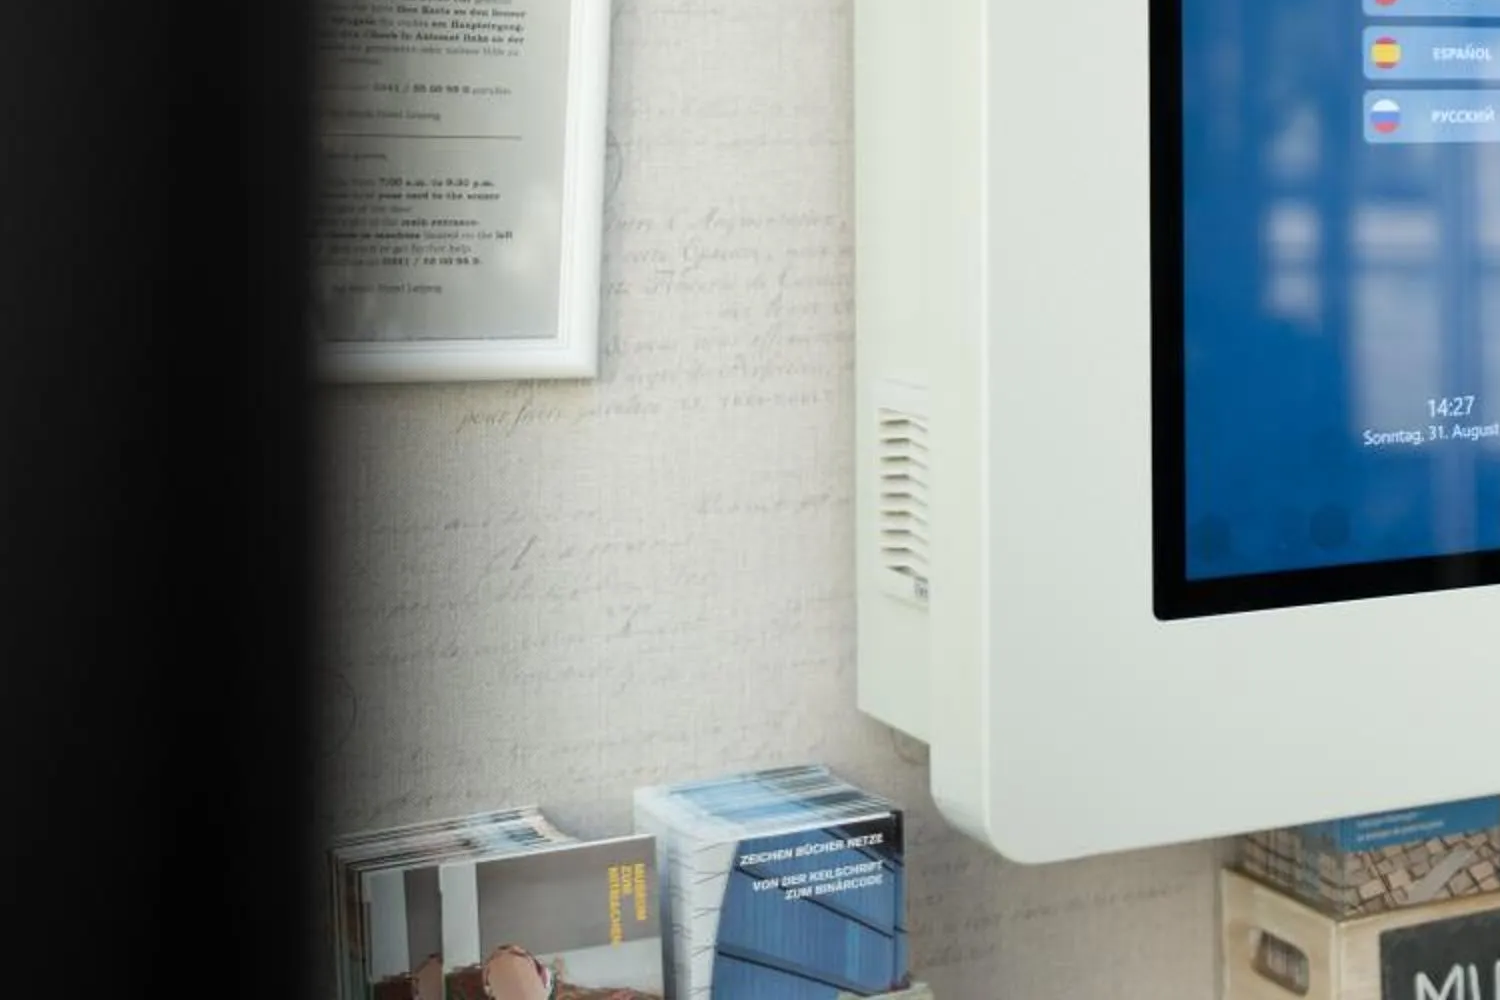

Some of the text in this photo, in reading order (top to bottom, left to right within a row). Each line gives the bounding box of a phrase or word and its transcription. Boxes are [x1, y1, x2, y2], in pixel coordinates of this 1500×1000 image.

[1433, 42, 1492, 61] ESPAÑOL
[1431, 105, 1495, 124] РУССКИЙ
[1427, 395, 1475, 418] 14:27
[1363, 429, 1425, 446] Sonntag,
[1428, 425, 1449, 441] 31.
[1452, 422, 1499, 442] August
[739, 832, 884, 868] ZEICHEN BÜCHER NETZE
[752, 860, 883, 893] VON DER KEILSCHRIFT
[784, 887, 812, 901] ZUM
